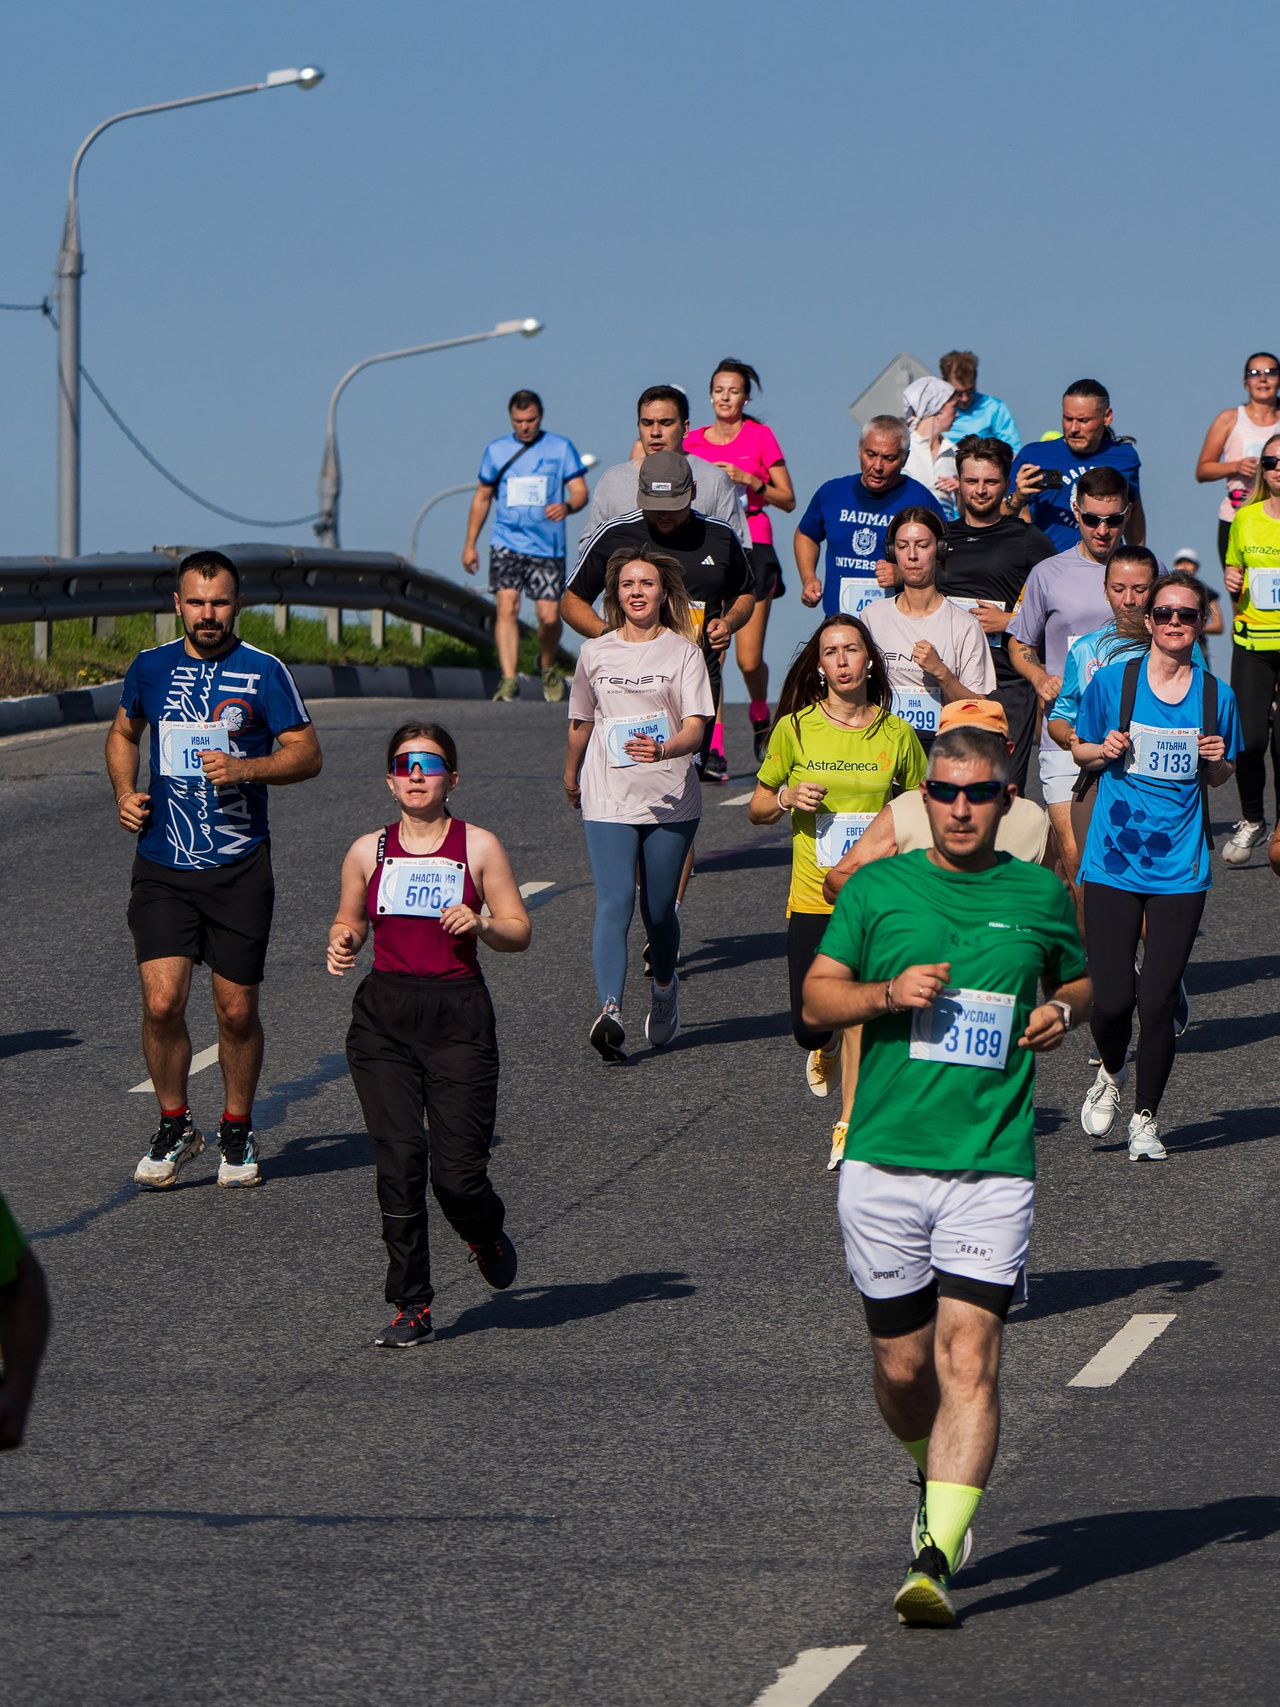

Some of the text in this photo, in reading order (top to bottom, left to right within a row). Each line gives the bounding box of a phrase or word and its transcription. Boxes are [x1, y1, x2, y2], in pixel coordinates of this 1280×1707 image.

[864, 589, 882, 597] ИГОРЬ
[597, 675, 669, 685] TENET
[908, 700, 922, 708] ЯНА
[191, 736, 210, 746] ИВАН
[1157, 741, 1187, 751] ТАТЬЯНА
[806, 760, 878, 772] AstraZeneca
[1149, 751, 1192, 774] 3133
[410, 873, 456, 885] АНАСТАИЯ
[405, 886, 456, 910] 5062
[955, 1008, 996, 1025] РУСЛАН
[945, 1024, 1003, 1059] 3189
[960, 1244, 987, 1257] GEAR
[872, 1270, 901, 1280] SPORT
